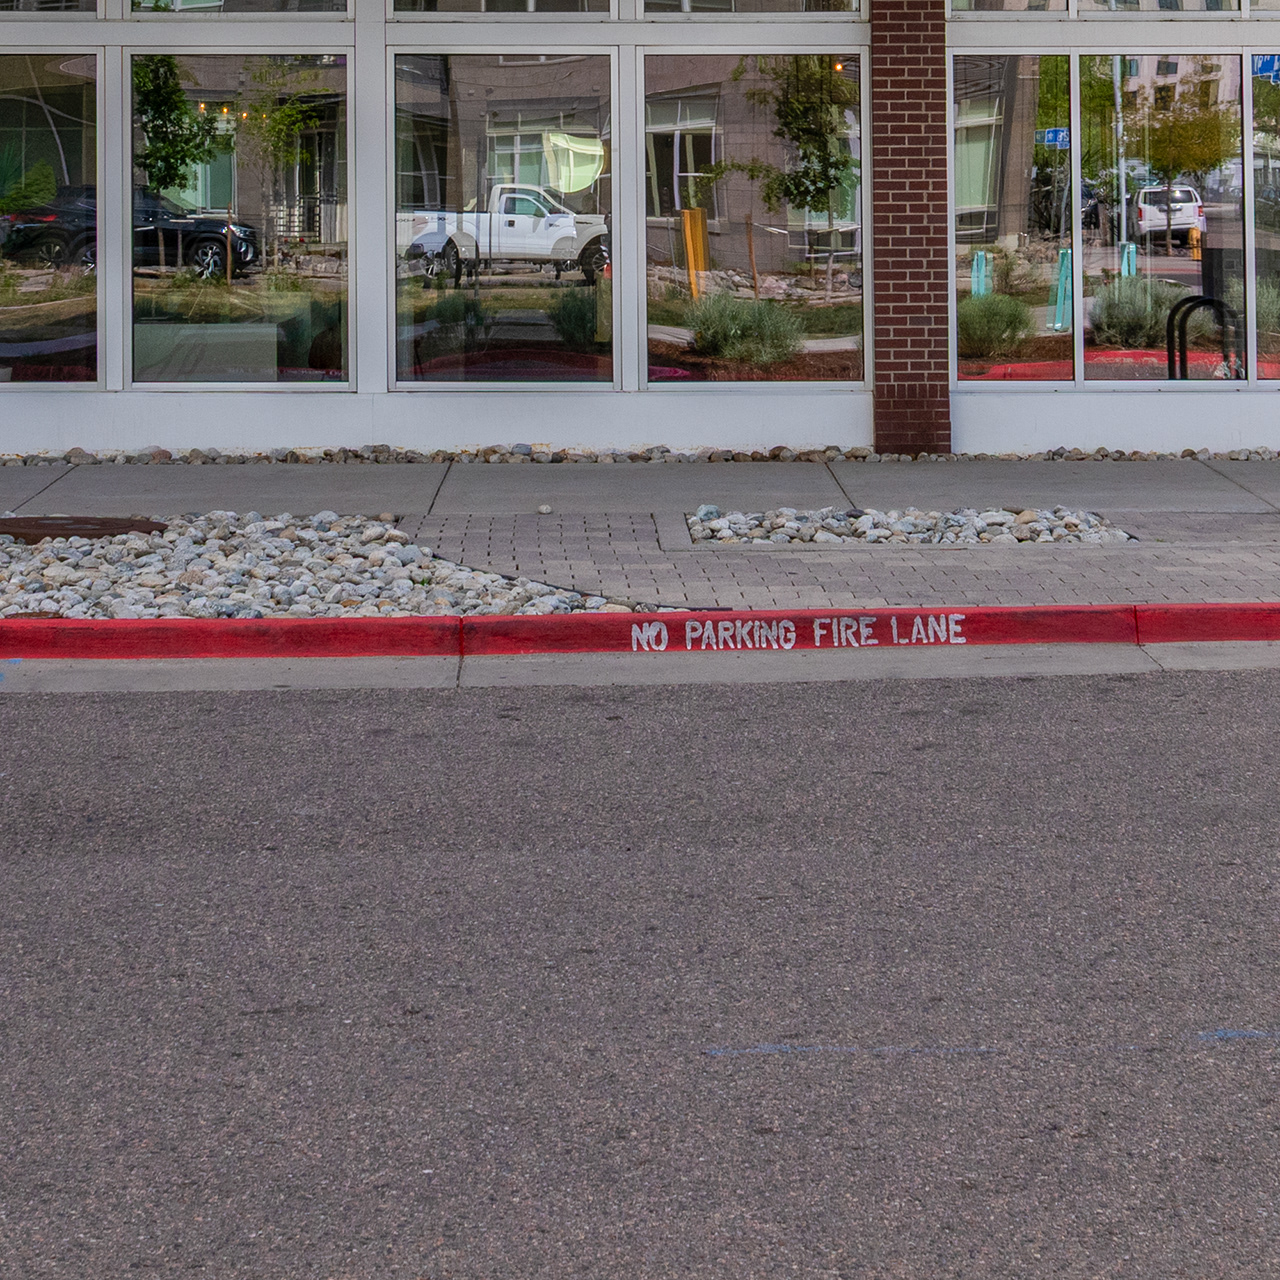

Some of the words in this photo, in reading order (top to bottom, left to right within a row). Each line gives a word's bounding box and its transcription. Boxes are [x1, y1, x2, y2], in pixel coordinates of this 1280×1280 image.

[631, 621, 668, 651] NO
[685, 619, 797, 650] PARKING
[813, 616, 879, 647] FIRE
[890, 614, 967, 644] LANE
